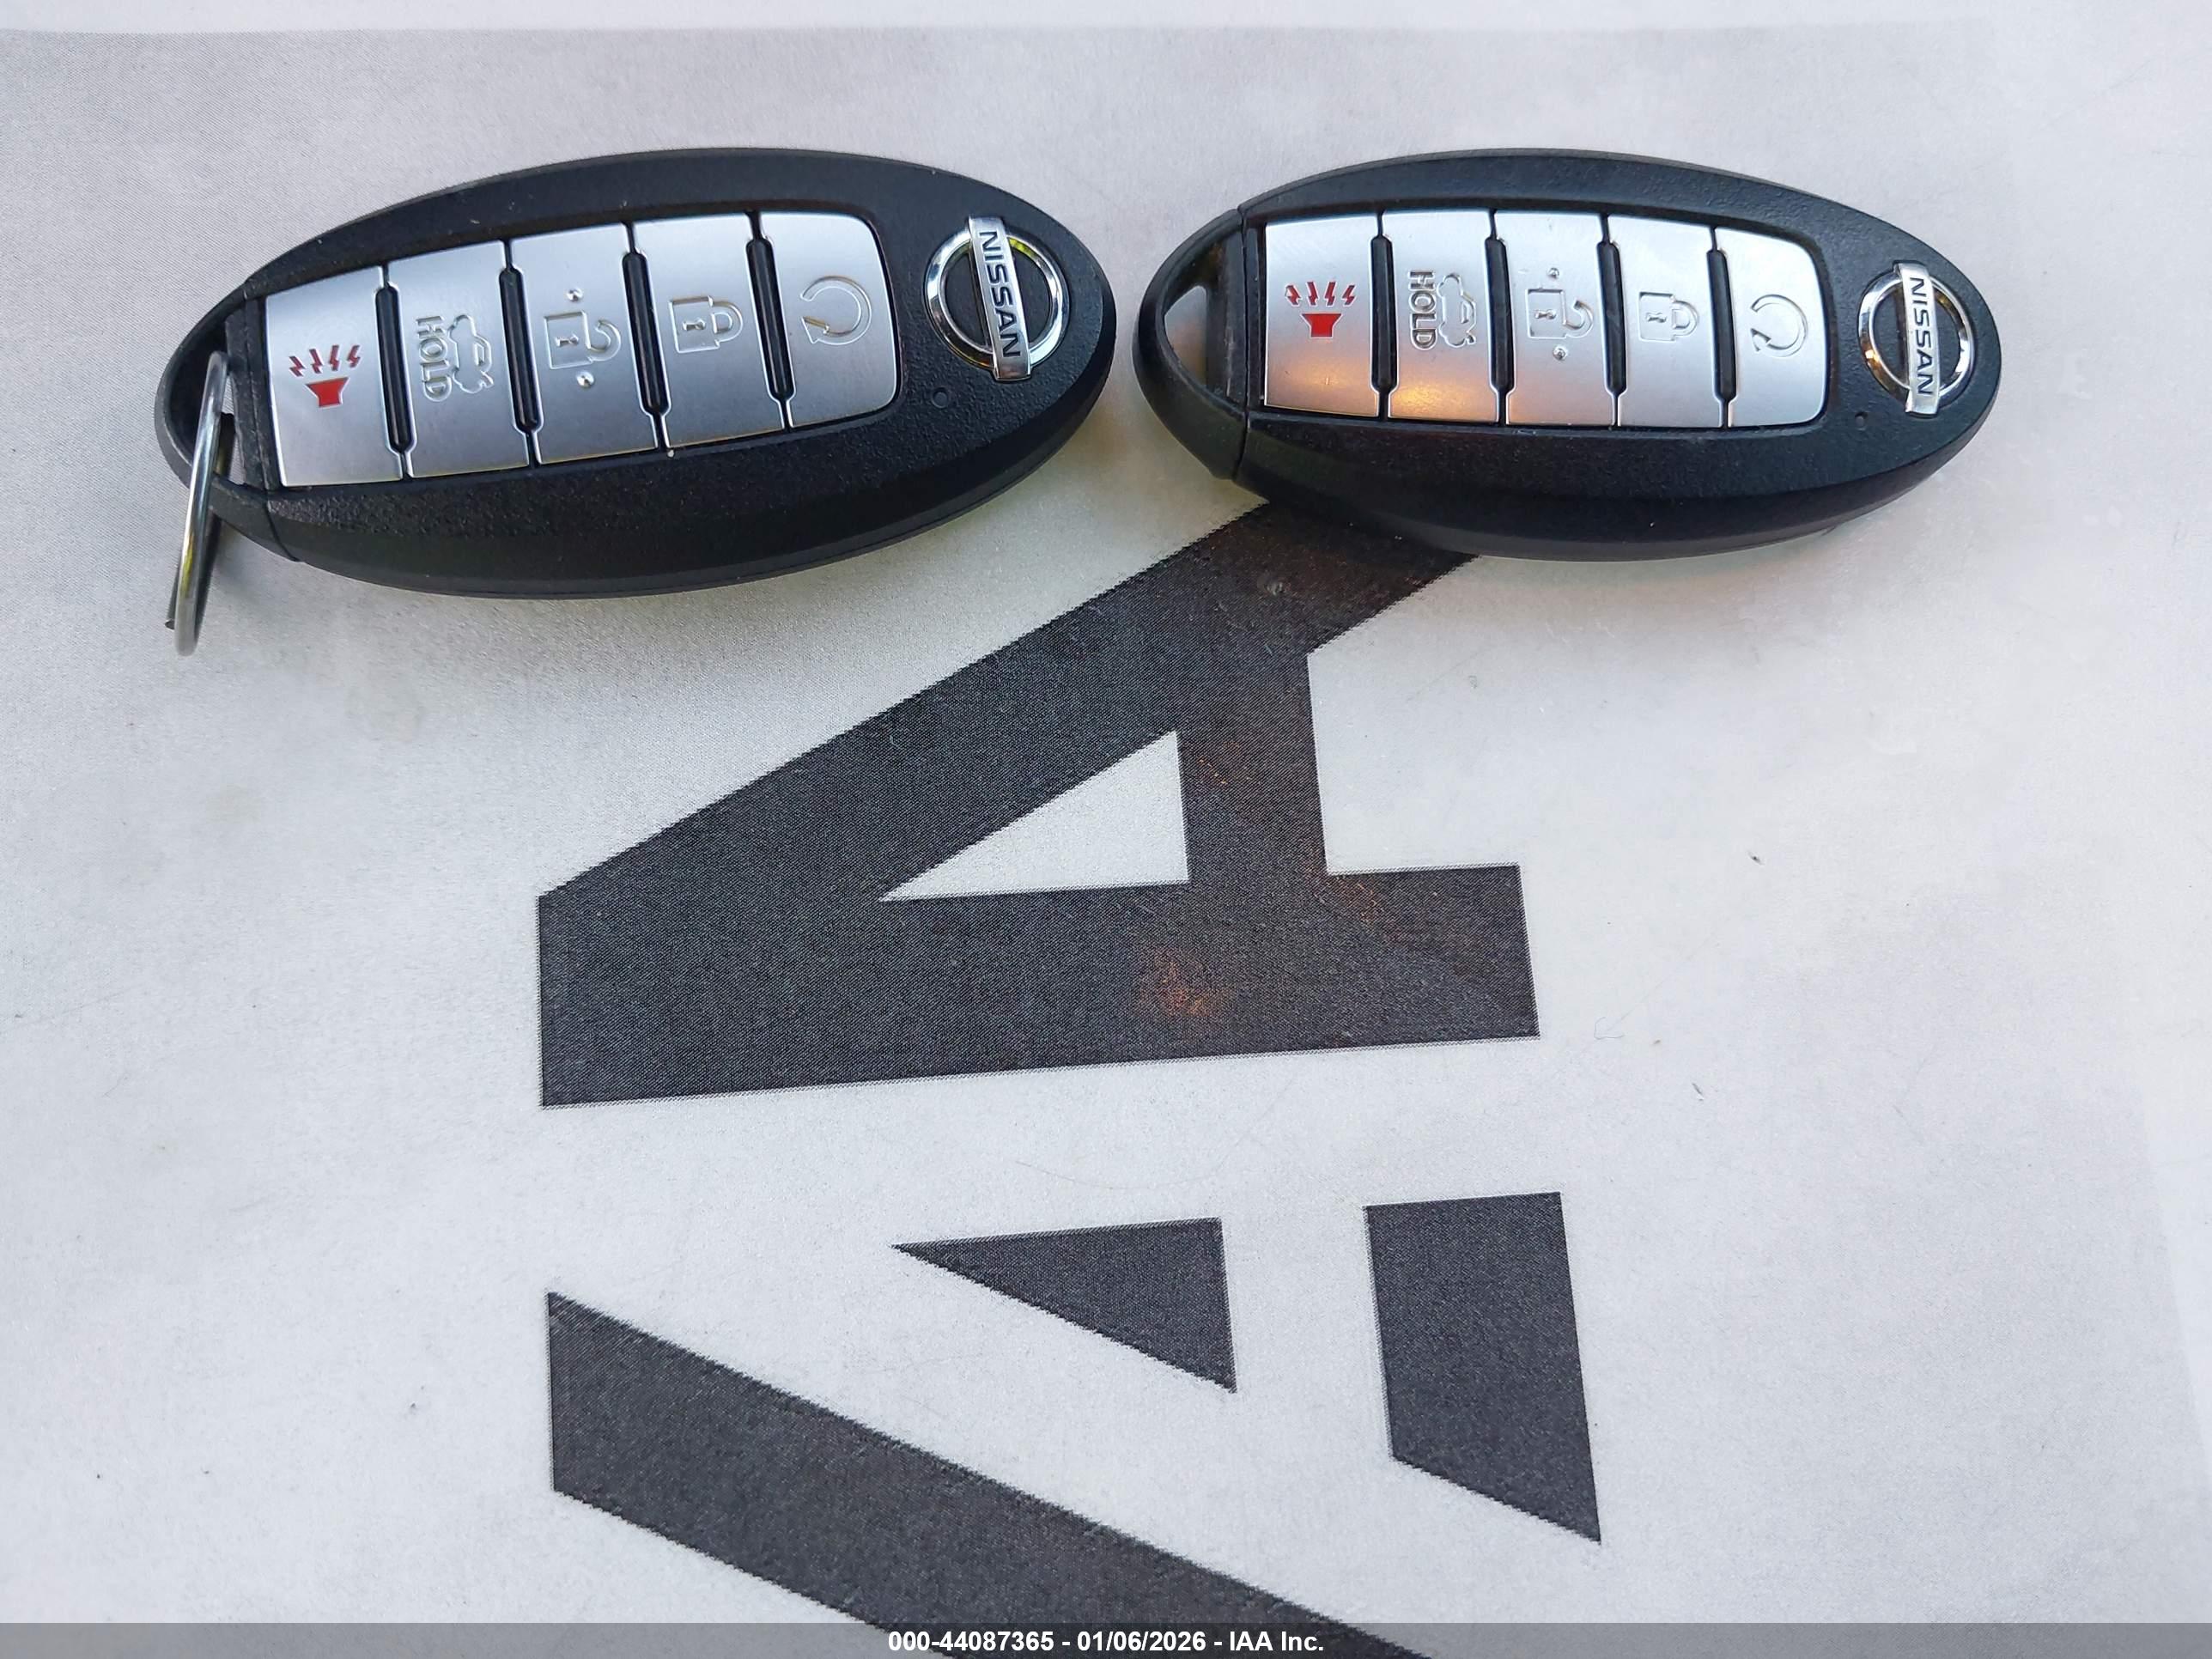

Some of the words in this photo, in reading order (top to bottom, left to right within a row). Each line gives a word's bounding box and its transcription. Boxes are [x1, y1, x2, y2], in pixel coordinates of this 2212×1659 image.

[979, 230, 1022, 358] NISSAN
[1408, 270, 1437, 350] HOLD
[1909, 276, 1935, 396] NISSAN
[416, 315, 453, 403] HOLD
